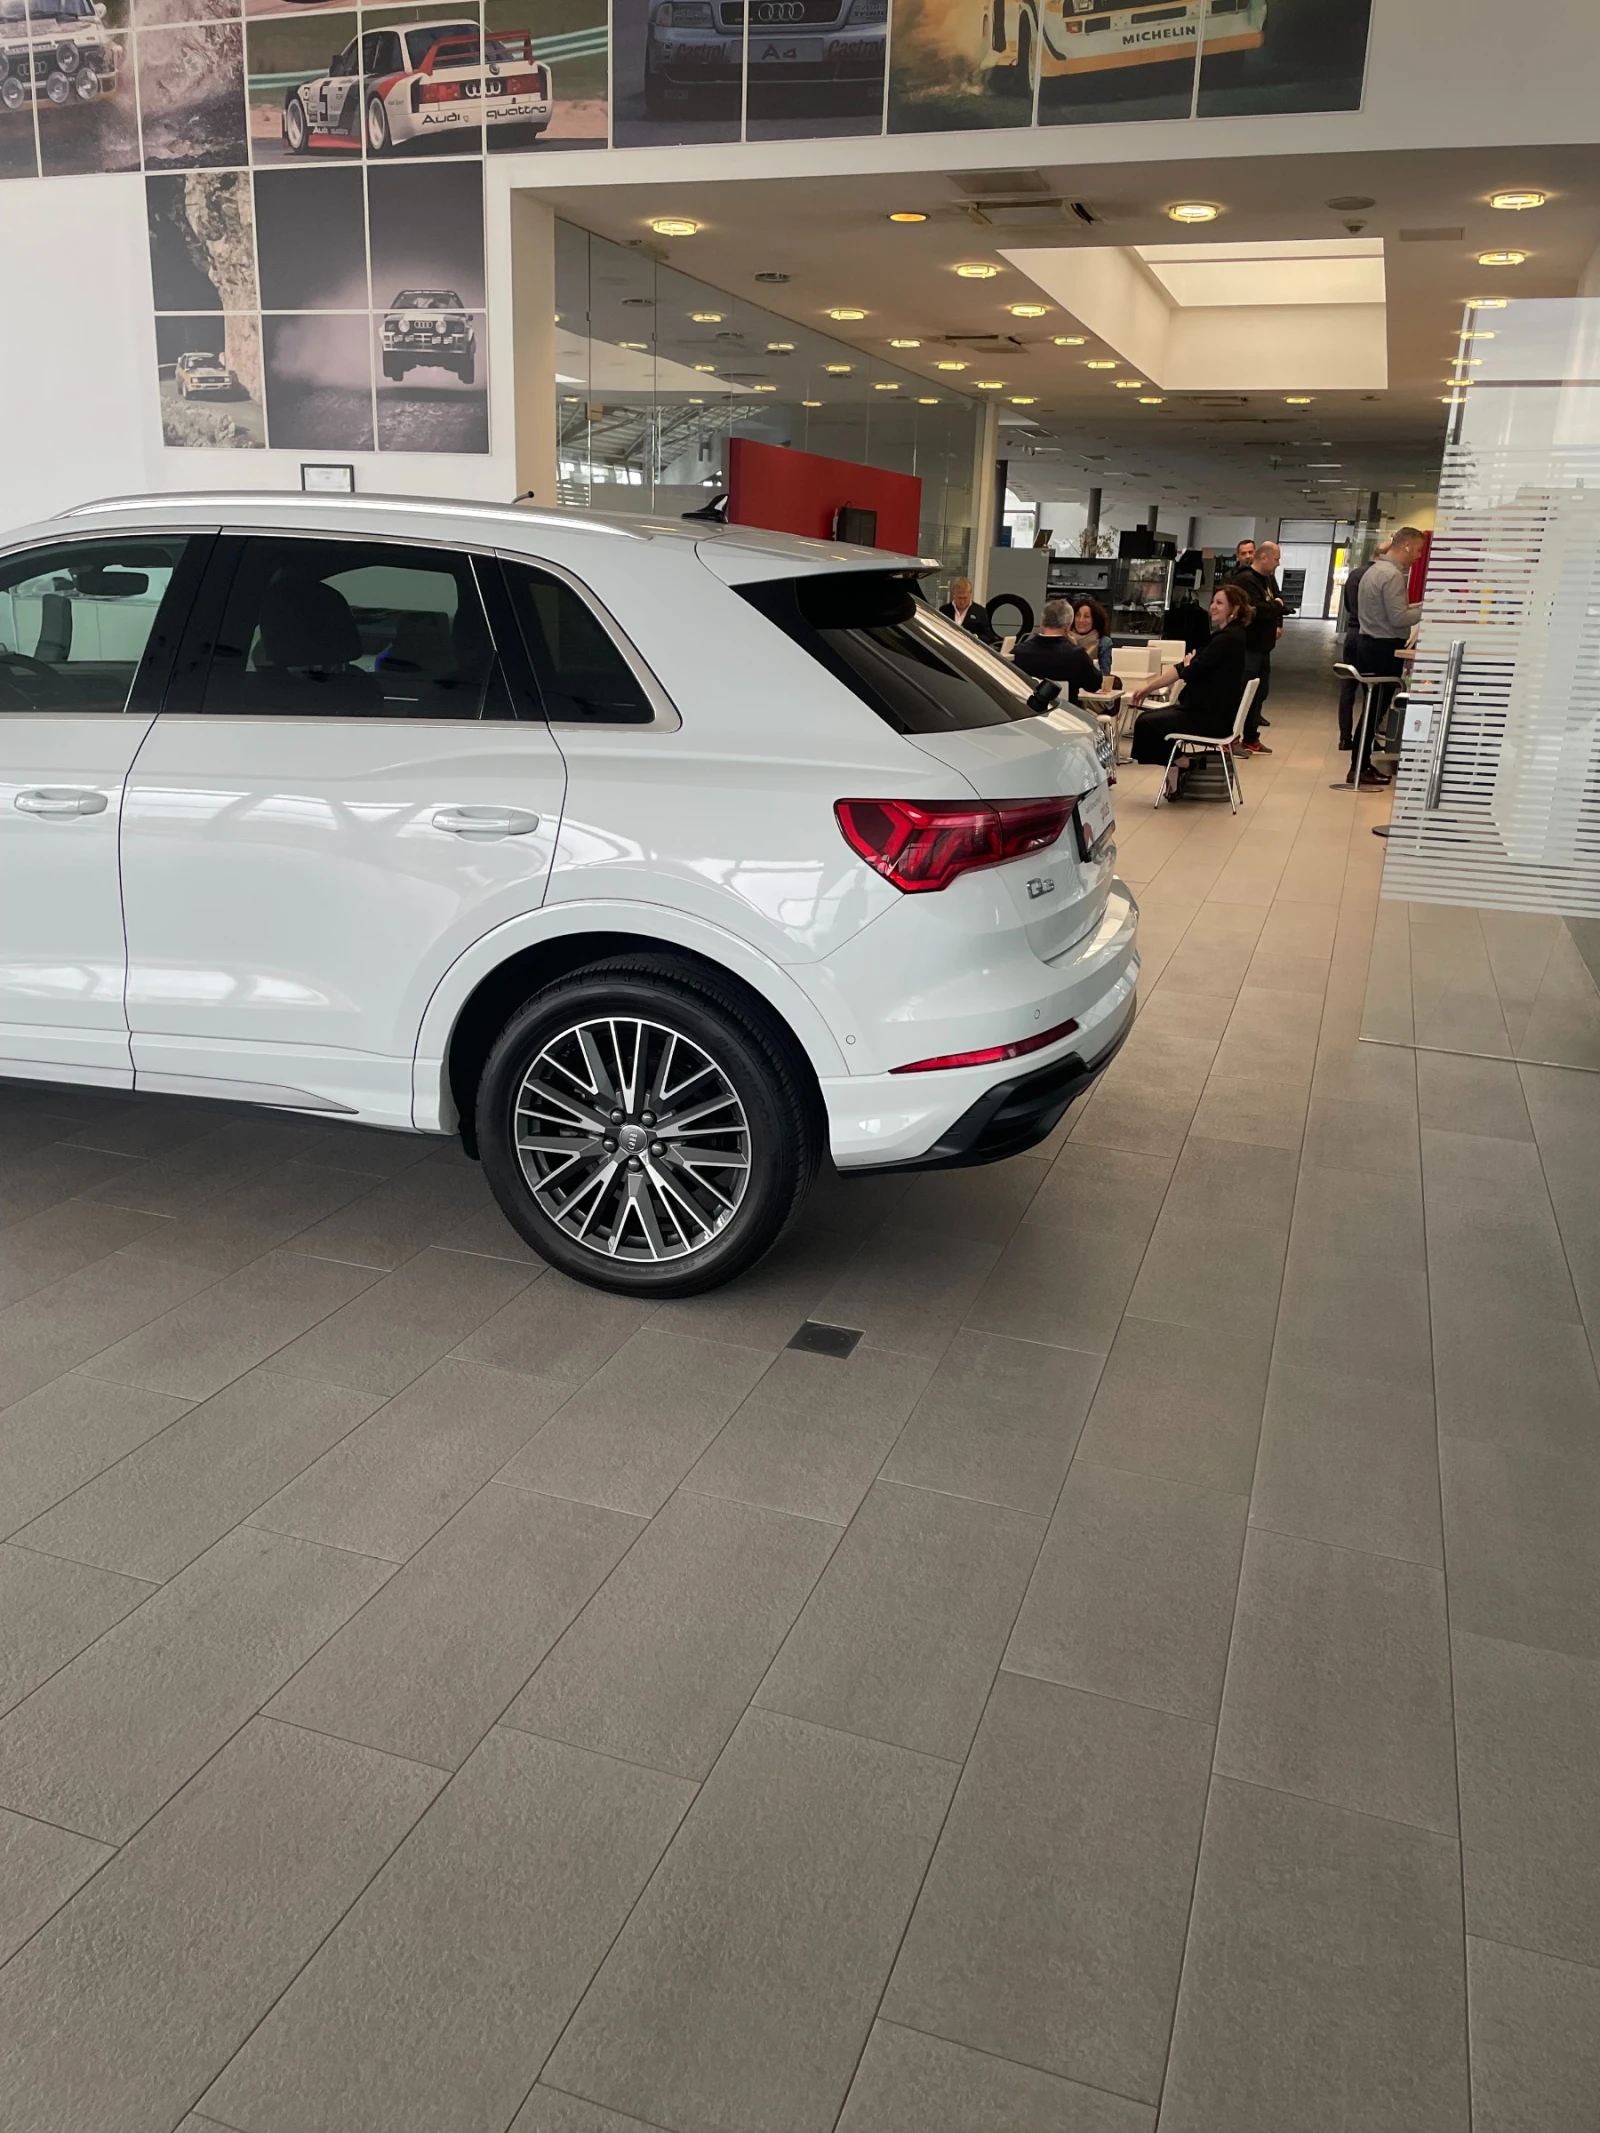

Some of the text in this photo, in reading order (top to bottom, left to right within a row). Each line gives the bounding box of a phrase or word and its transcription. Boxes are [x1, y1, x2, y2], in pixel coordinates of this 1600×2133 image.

[1122, 25, 1196, 45] MICHELIN
[761, 44, 797, 60] A4
[422, 105, 547, 125] Audi quattro
[1026, 878, 1055, 900] Q3
